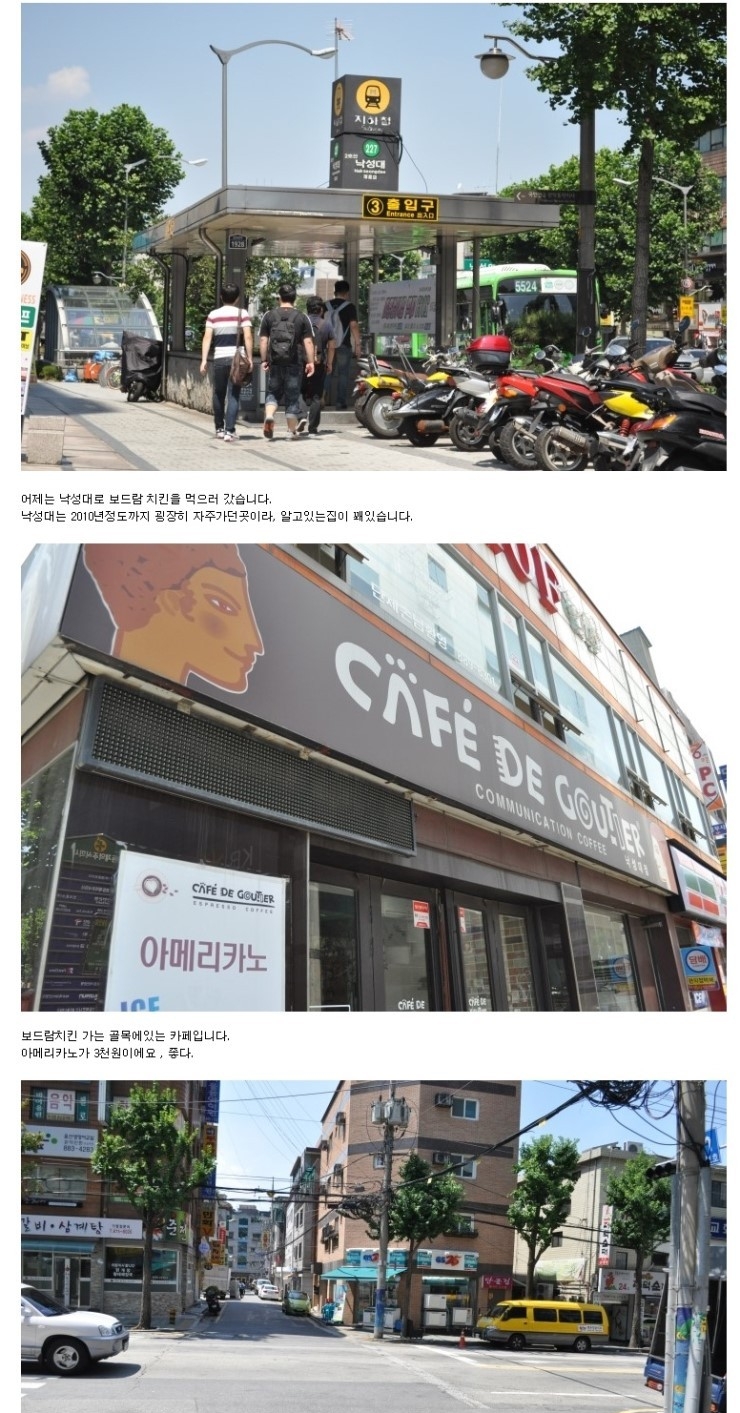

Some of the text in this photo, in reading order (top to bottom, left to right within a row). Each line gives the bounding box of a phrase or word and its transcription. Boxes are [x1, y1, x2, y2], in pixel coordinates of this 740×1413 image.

[365, 144, 378, 154] 227
[355, 160, 386, 169] 낙성대
[386, 199, 434, 212] 출입구
[515, 280, 537, 293] 5524
[492, 735, 545, 806] DE
[475, 783, 608, 856] COMMUNICATION COFFEE
[220, 887, 234, 898] DE
[140, 936, 267, 973] 아메리카노
[688, 955, 707, 965] 담배
[416, 1000, 425, 1010] DE
[50, 1093, 73, 1112] 음악
[58, 1220, 104, 1235] 삼계탕
